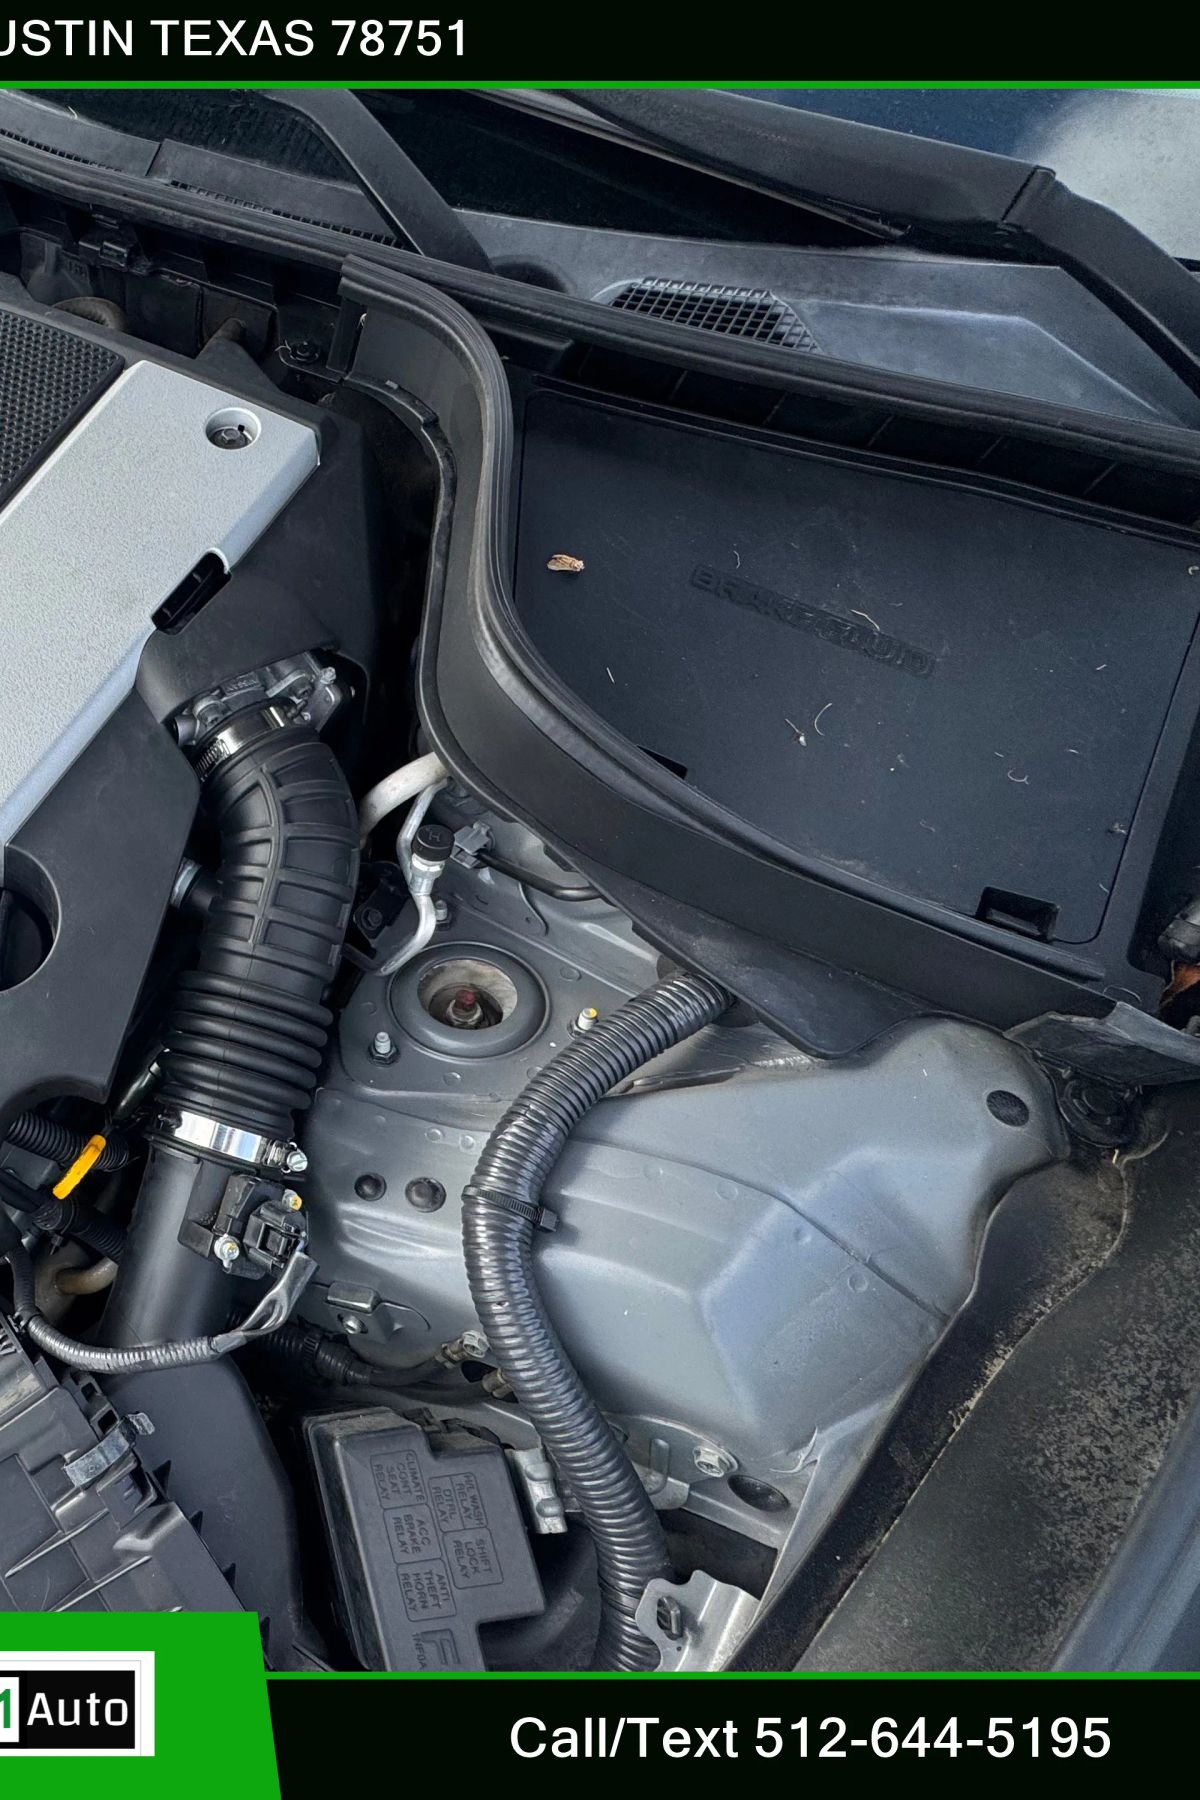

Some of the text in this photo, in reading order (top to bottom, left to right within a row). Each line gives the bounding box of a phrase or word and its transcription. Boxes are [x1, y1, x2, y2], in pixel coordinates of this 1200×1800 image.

[373, 1463, 390, 1500] RELAY
[385, 1466, 400, 1494] SEAT
[396, 1462, 412, 1495] CONT
[405, 1452, 425, 1502] CLIMATE
[431, 1486, 449, 1523] RELAY
[455, 1482, 473, 1520] RELAY
[469, 1494, 484, 1526] WASH
[392, 1516, 409, 1554] RELAY
[403, 1513, 421, 1554] BRAKE
[415, 1518, 431, 1546] ACC
[452, 1540, 470, 1579] RELAY
[463, 1541, 480, 1574] LOCK
[475, 1538, 493, 1574] SHIFT
[400, 1573, 418, 1612] RELAY
[411, 1572, 429, 1609] HORN
[424, 1569, 442, 1609] THEFT
[436, 1573, 451, 1601] ANTI
